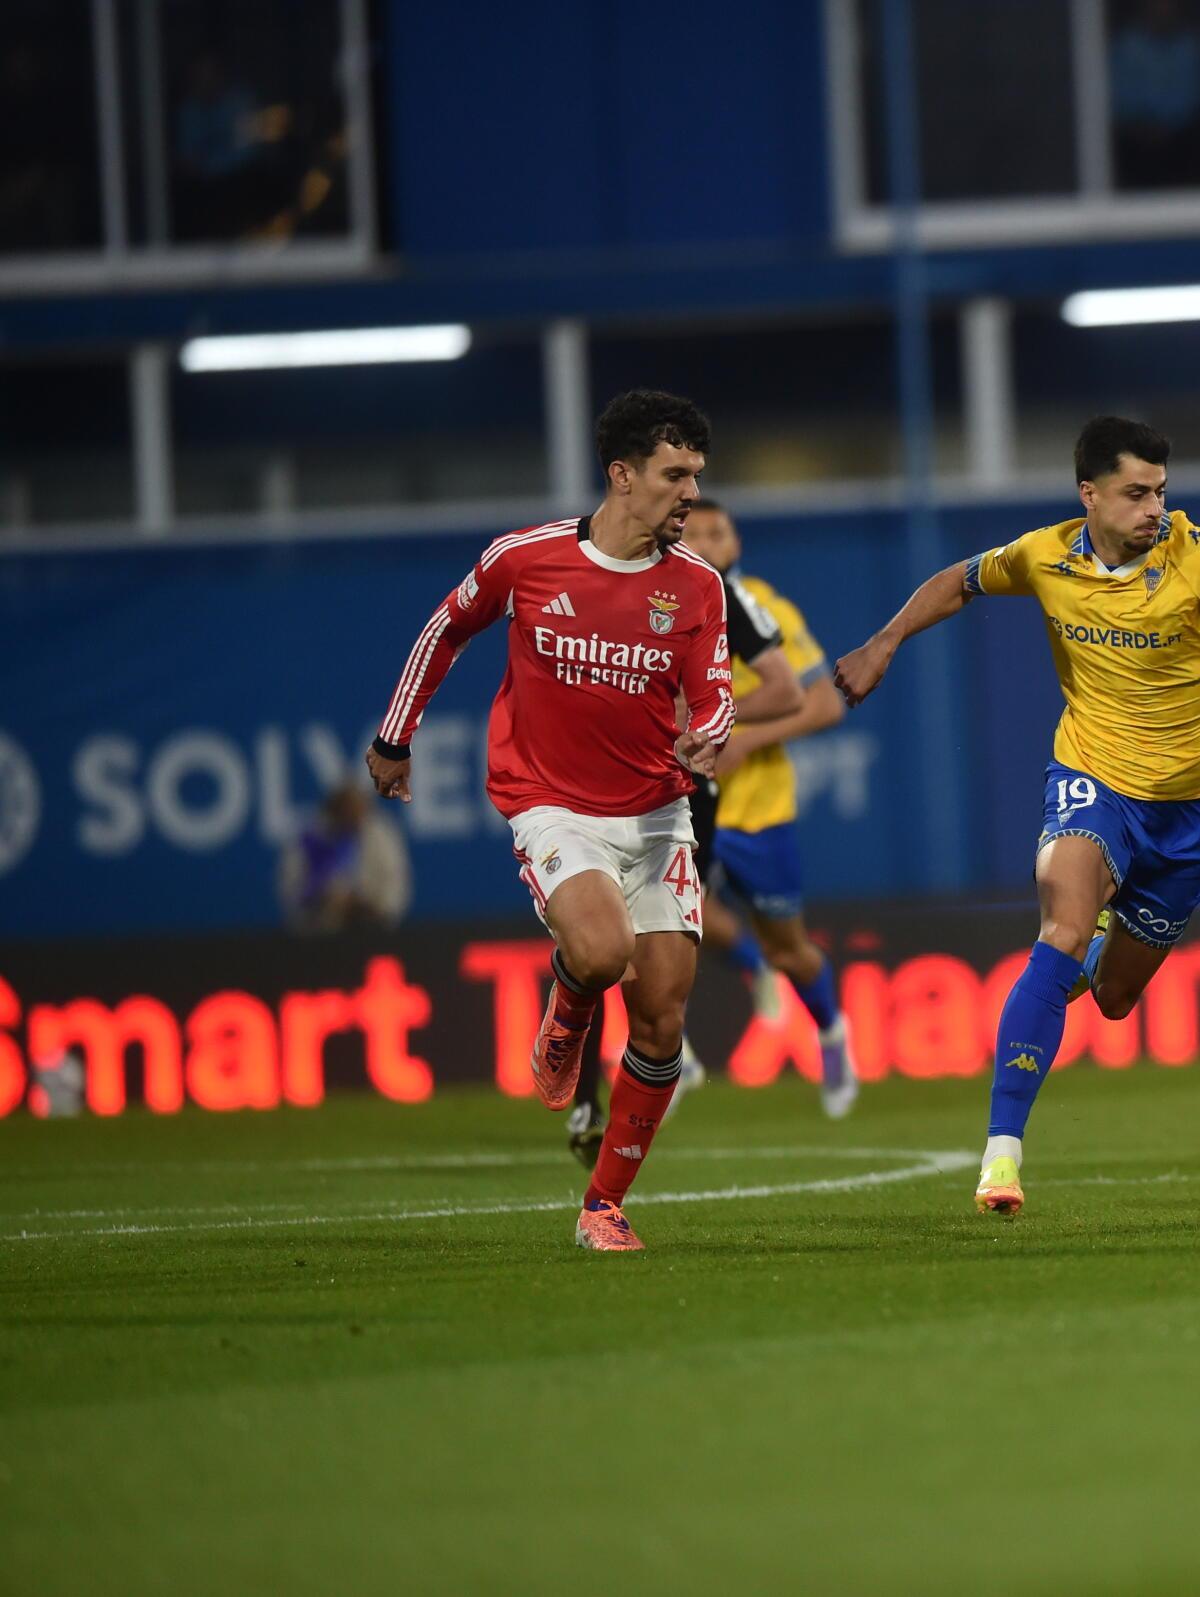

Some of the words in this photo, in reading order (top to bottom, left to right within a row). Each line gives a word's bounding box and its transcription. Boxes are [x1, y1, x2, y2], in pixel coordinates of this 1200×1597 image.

[534, 626, 673, 672] Emirates
[557, 663, 584, 685] FLY
[591, 667, 649, 694] BETTER
[1057, 777, 1097, 813] 19
